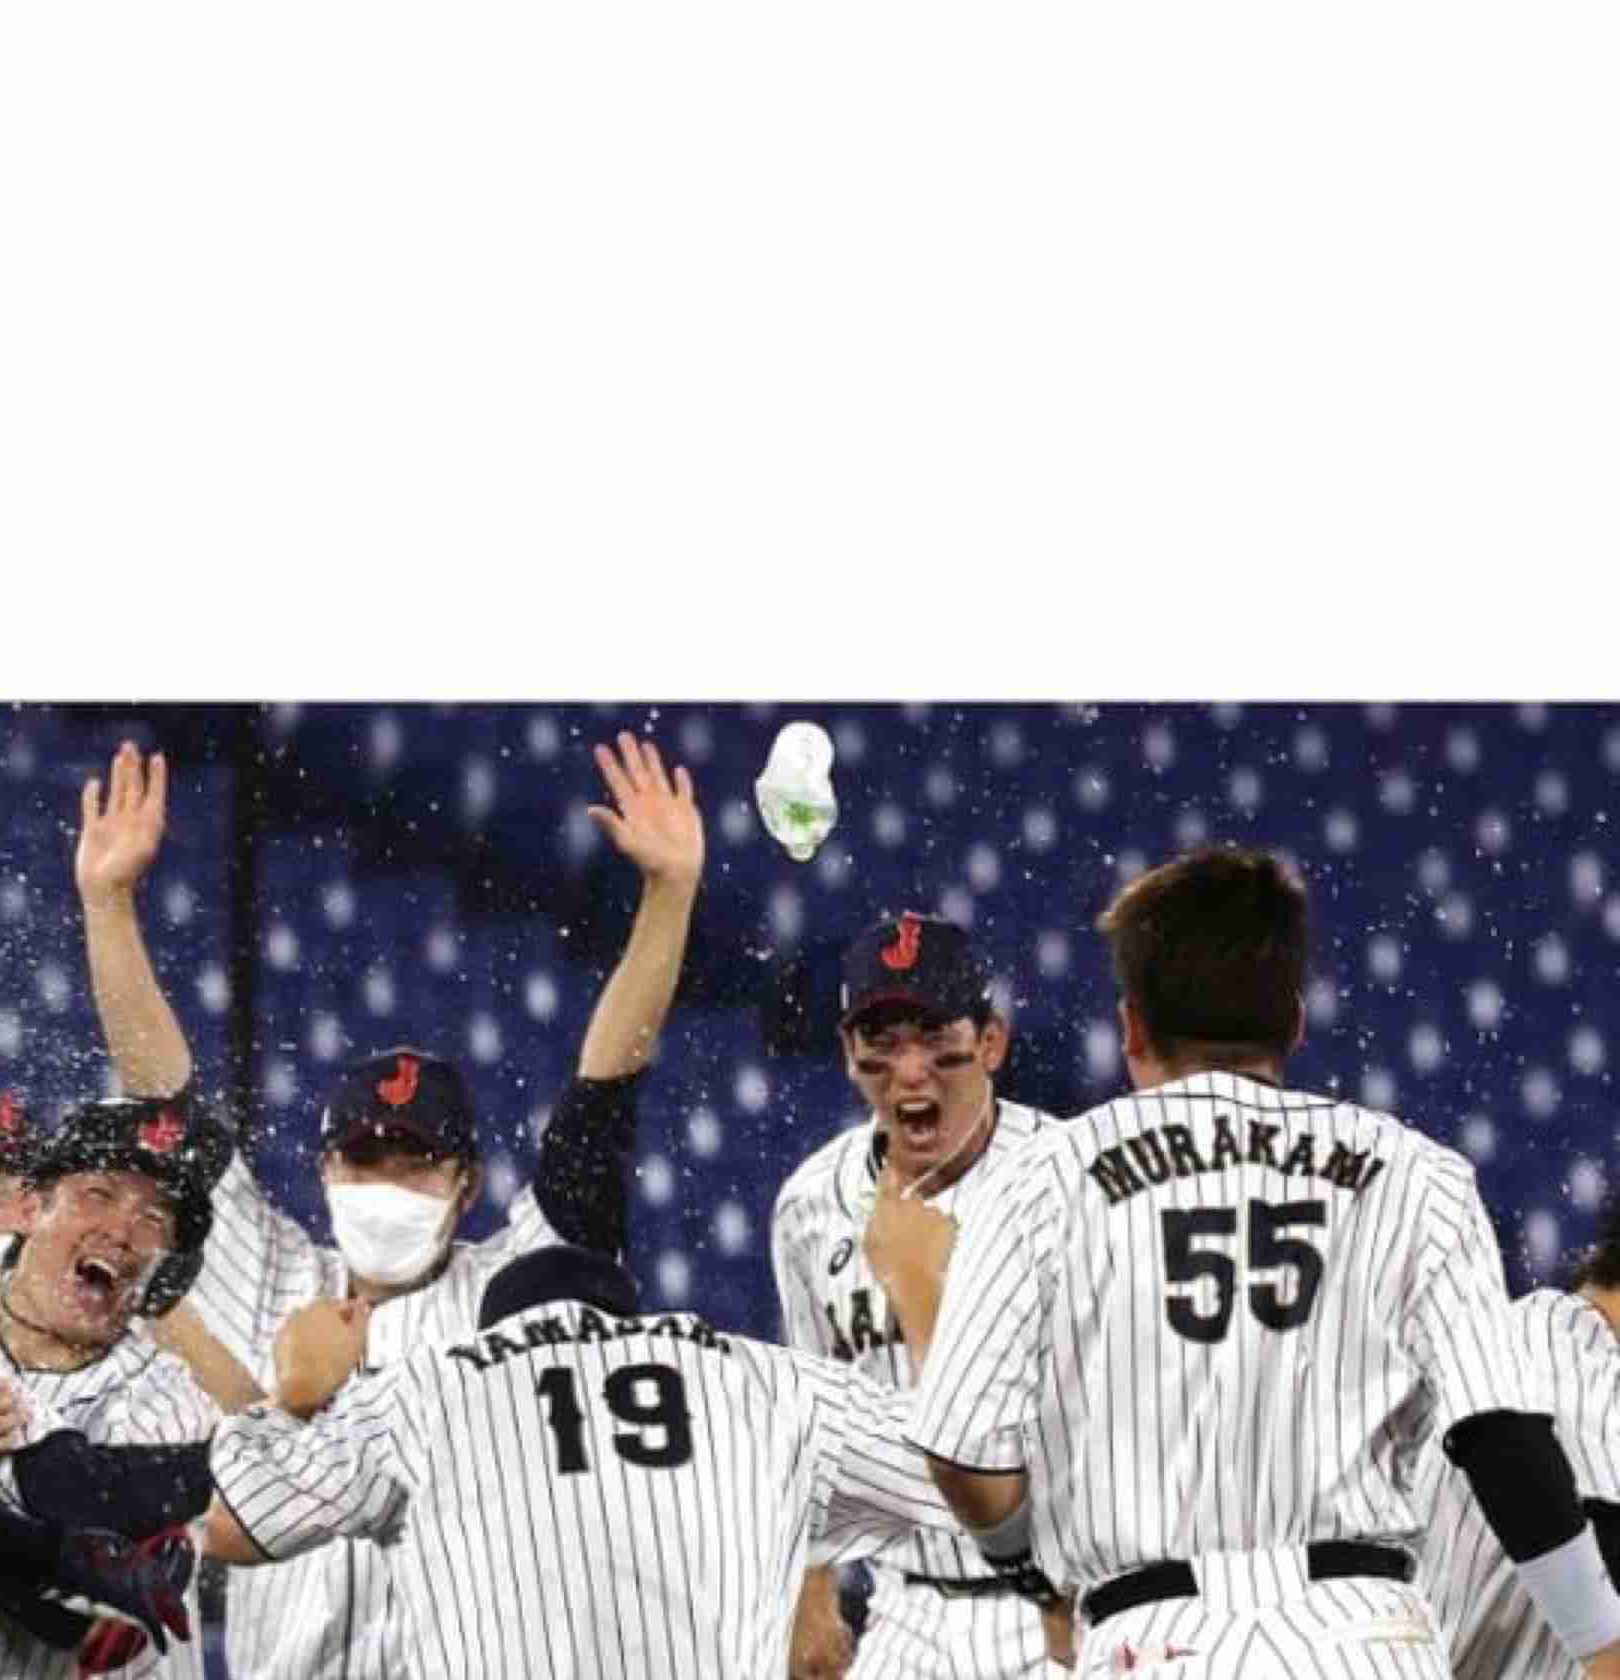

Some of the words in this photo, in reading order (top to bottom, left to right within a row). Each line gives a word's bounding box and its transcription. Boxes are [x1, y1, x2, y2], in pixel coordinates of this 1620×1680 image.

[1088, 1115, 1384, 1206] MURAKAMI
[1160, 1198, 1327, 1345] 55
[536, 1363, 695, 1475] 19
